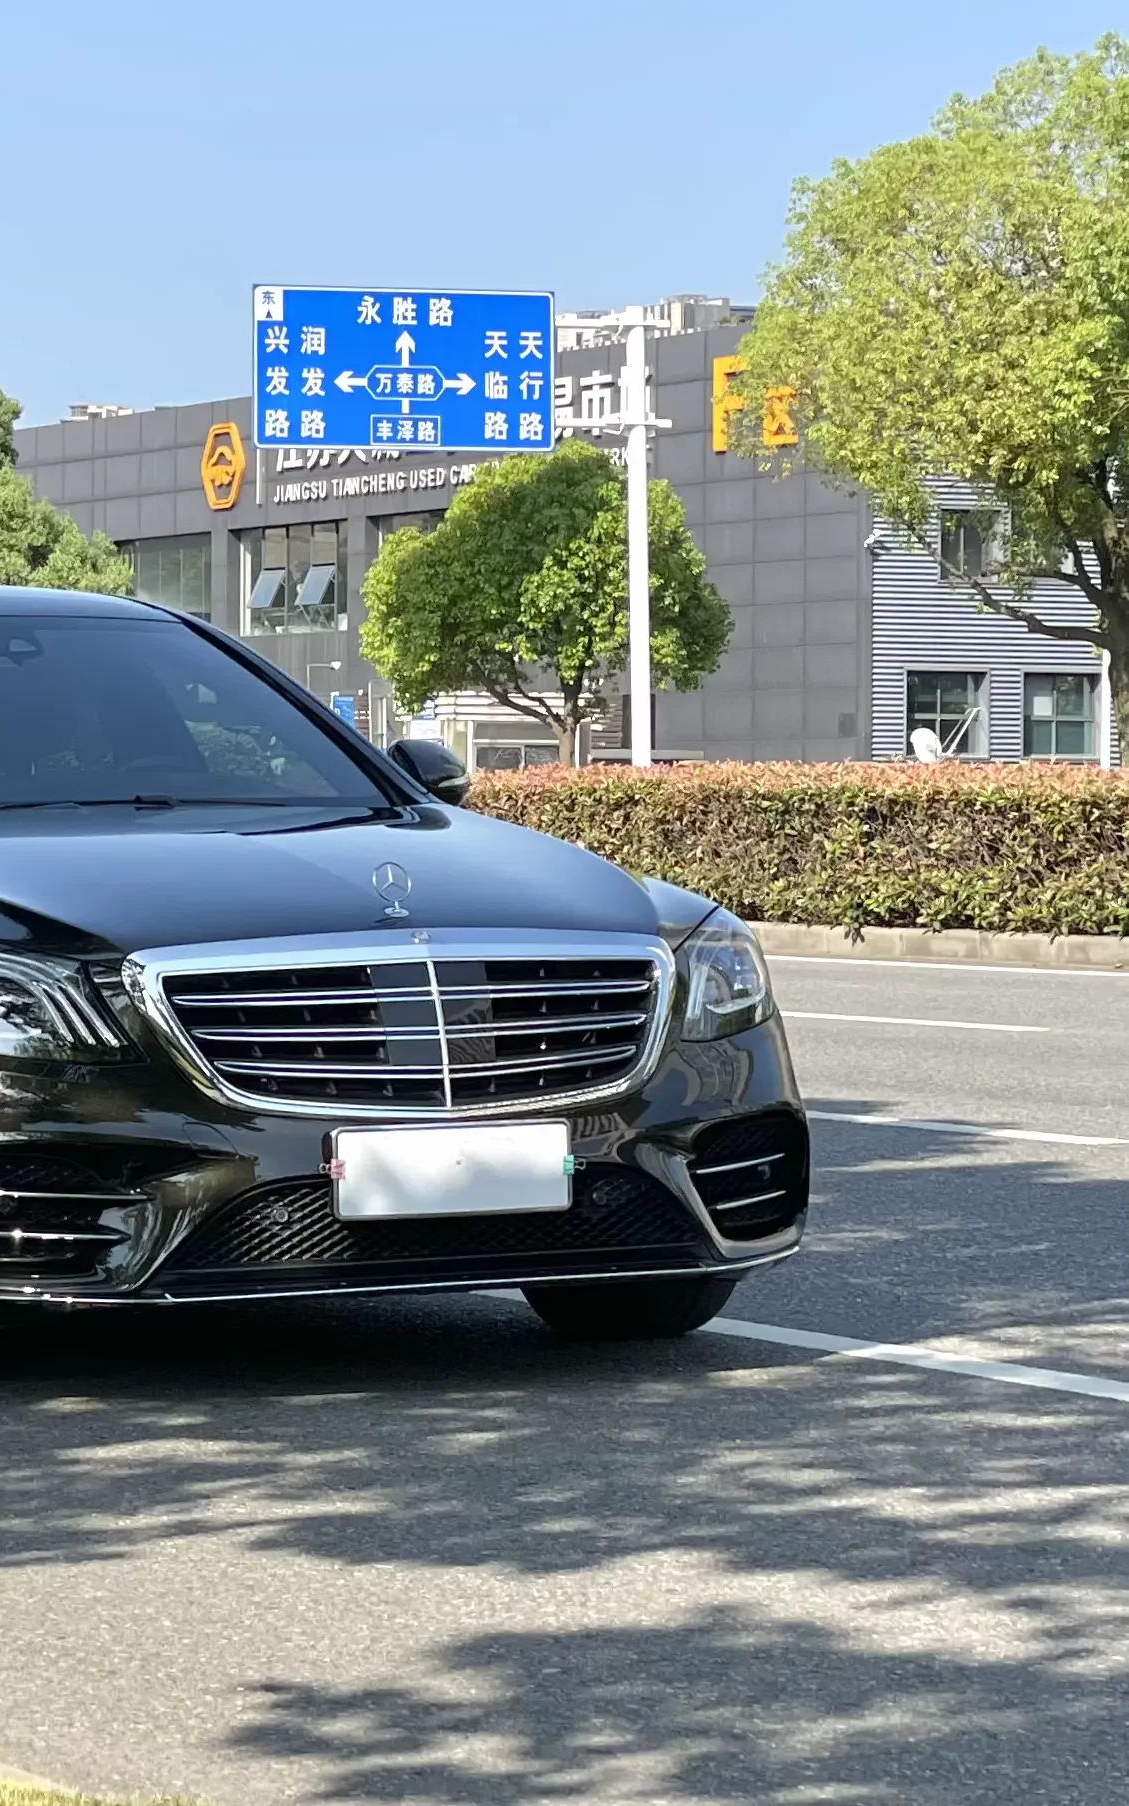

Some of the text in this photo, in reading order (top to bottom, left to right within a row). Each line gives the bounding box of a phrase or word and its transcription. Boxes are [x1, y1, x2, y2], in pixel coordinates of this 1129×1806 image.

[261, 290, 276, 305] 东
[357, 296, 454, 327] 永胜路
[265, 325, 290, 438] 兴发路
[300, 325, 326, 439] 润发路
[375, 372, 436, 395] 万泰路
[484, 331, 509, 441] 天临路
[519, 331, 544, 441] 天行路
[376, 419, 436, 442] 丰泽路
[274, 480, 327, 503] JIANGSU
[331, 471, 407, 497] TIANCHENG
[409, 467, 447, 489] USED
